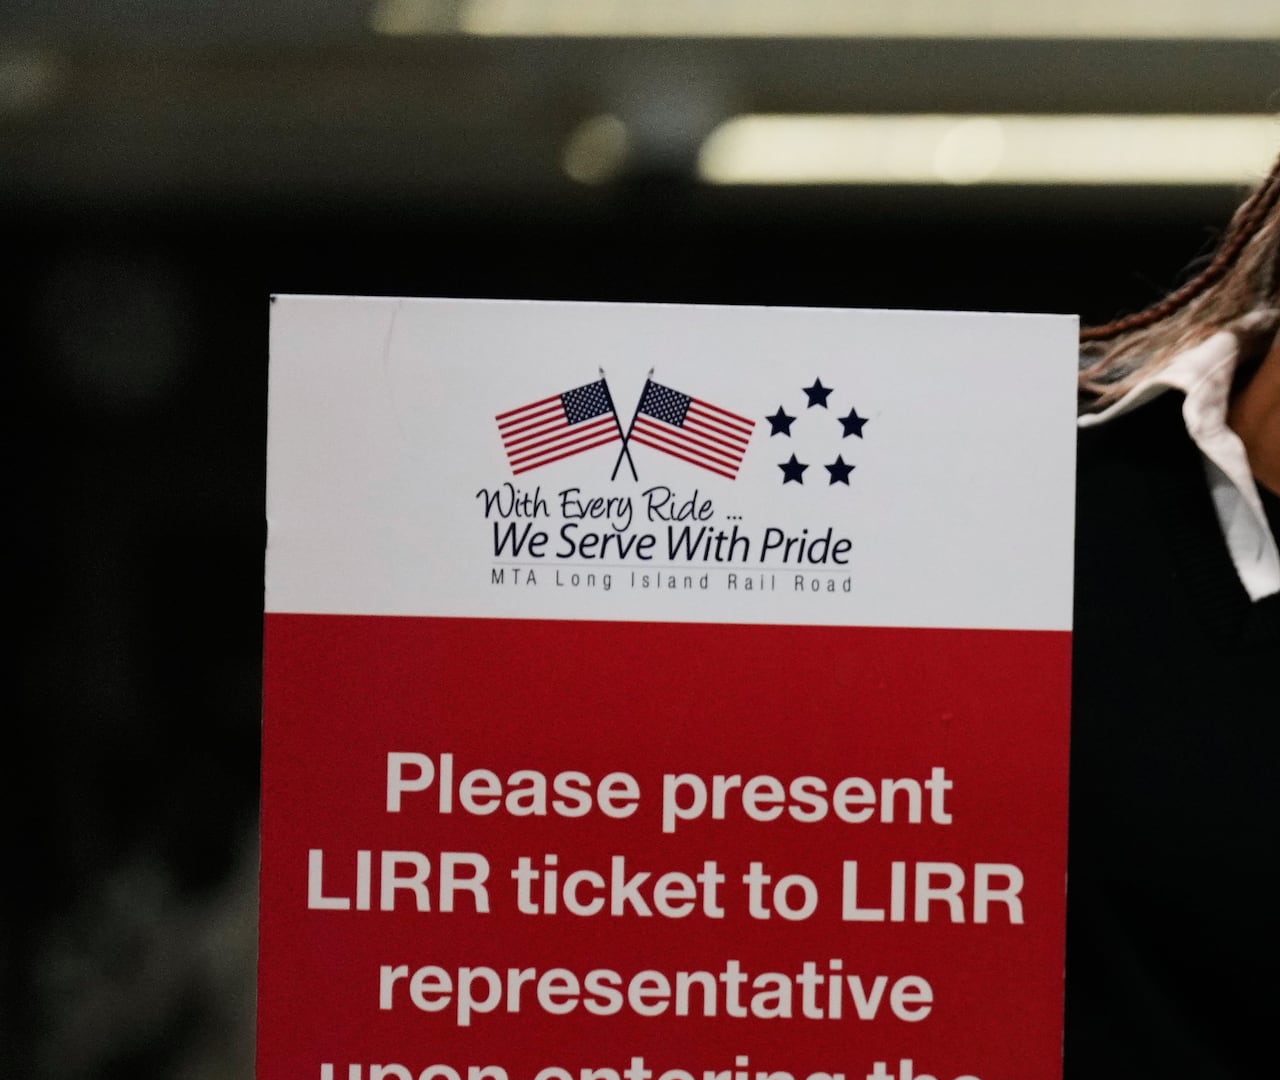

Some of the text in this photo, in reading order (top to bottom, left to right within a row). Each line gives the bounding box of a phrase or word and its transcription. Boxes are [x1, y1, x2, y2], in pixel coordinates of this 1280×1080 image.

[476, 482, 550, 519] With
[558, 487, 633, 533] Every
[641, 488, 714, 521] Ride
[491, 521, 853, 566] We Serve With Pride
[491, 567, 851, 593] MTA Long Island Rail Road
[386, 751, 954, 834] Please present
[307, 848, 1025, 925] LIRR ticket to LIRR
[379, 958, 934, 1027] representative
